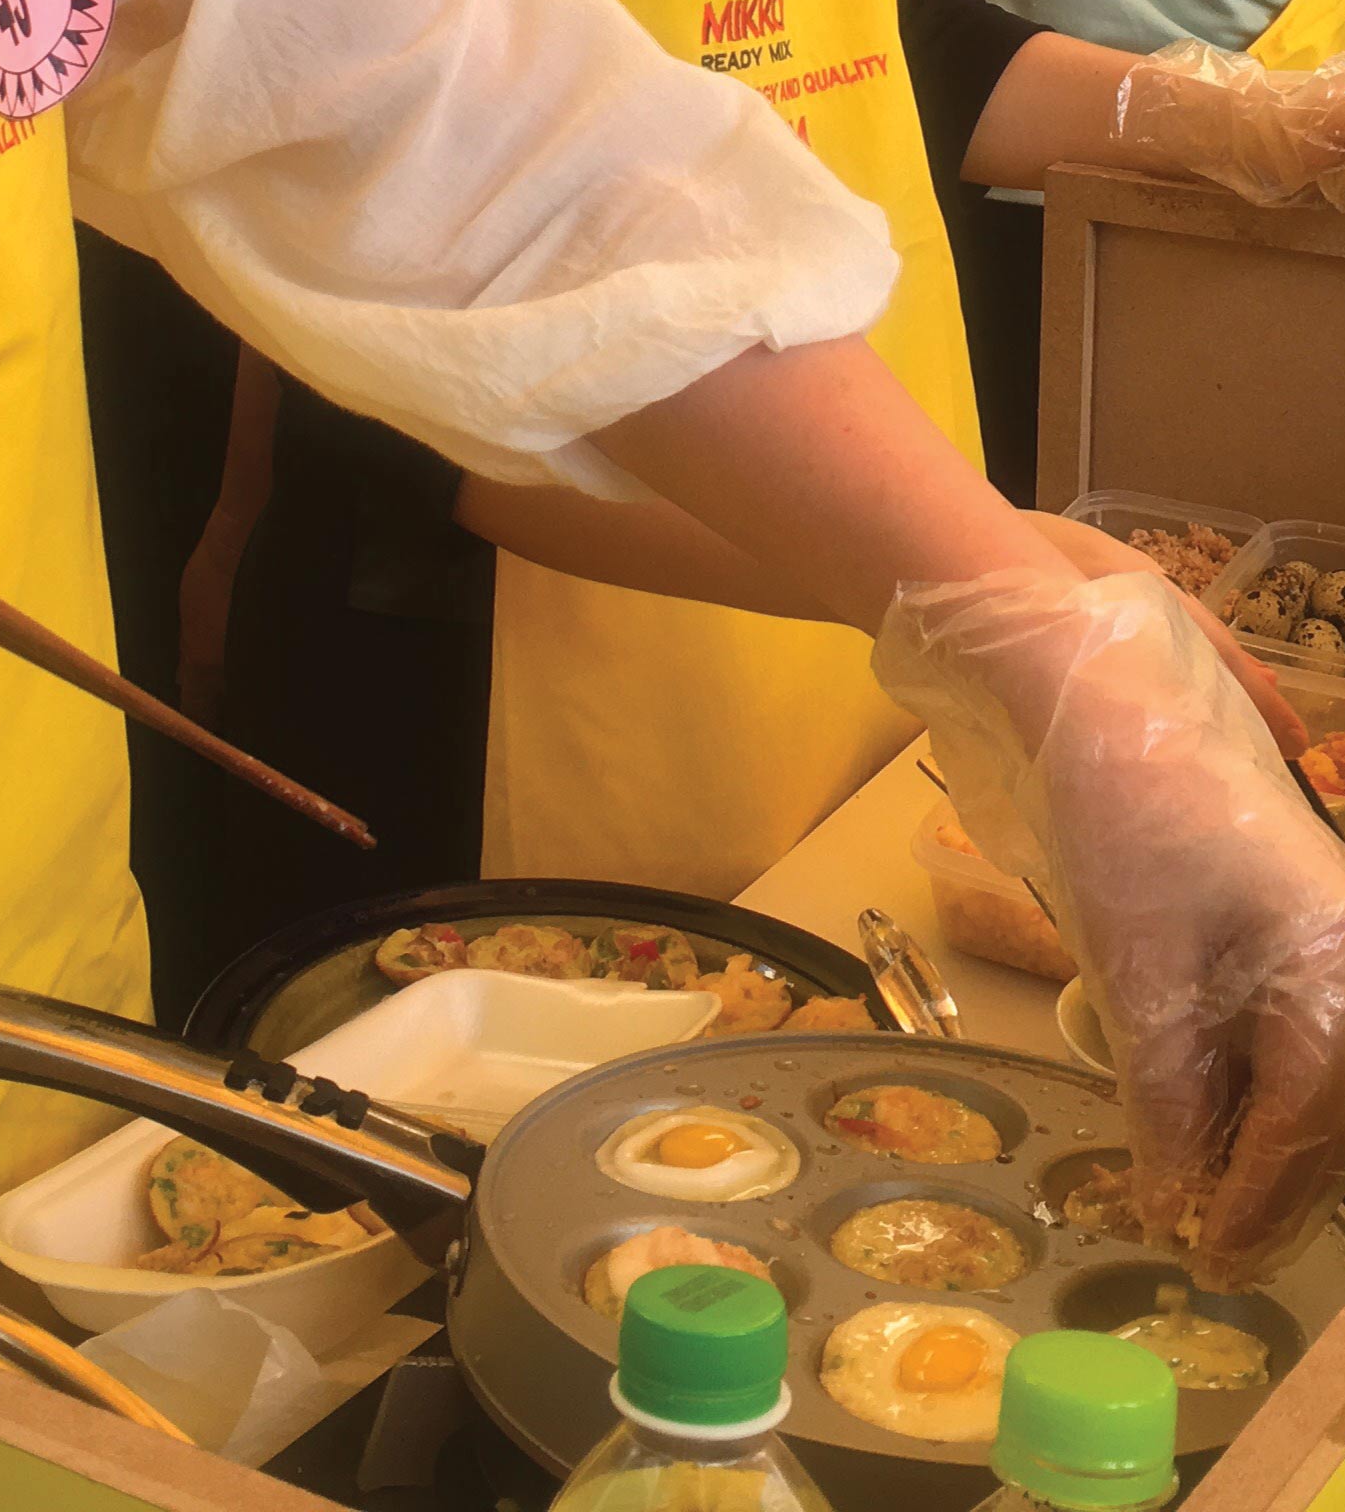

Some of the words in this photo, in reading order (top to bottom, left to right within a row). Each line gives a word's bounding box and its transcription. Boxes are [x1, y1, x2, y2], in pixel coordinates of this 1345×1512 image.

[701, 46, 763, 72] READY
[768, 39, 794, 63] MIX
[803, 53, 888, 94] QUALITY
